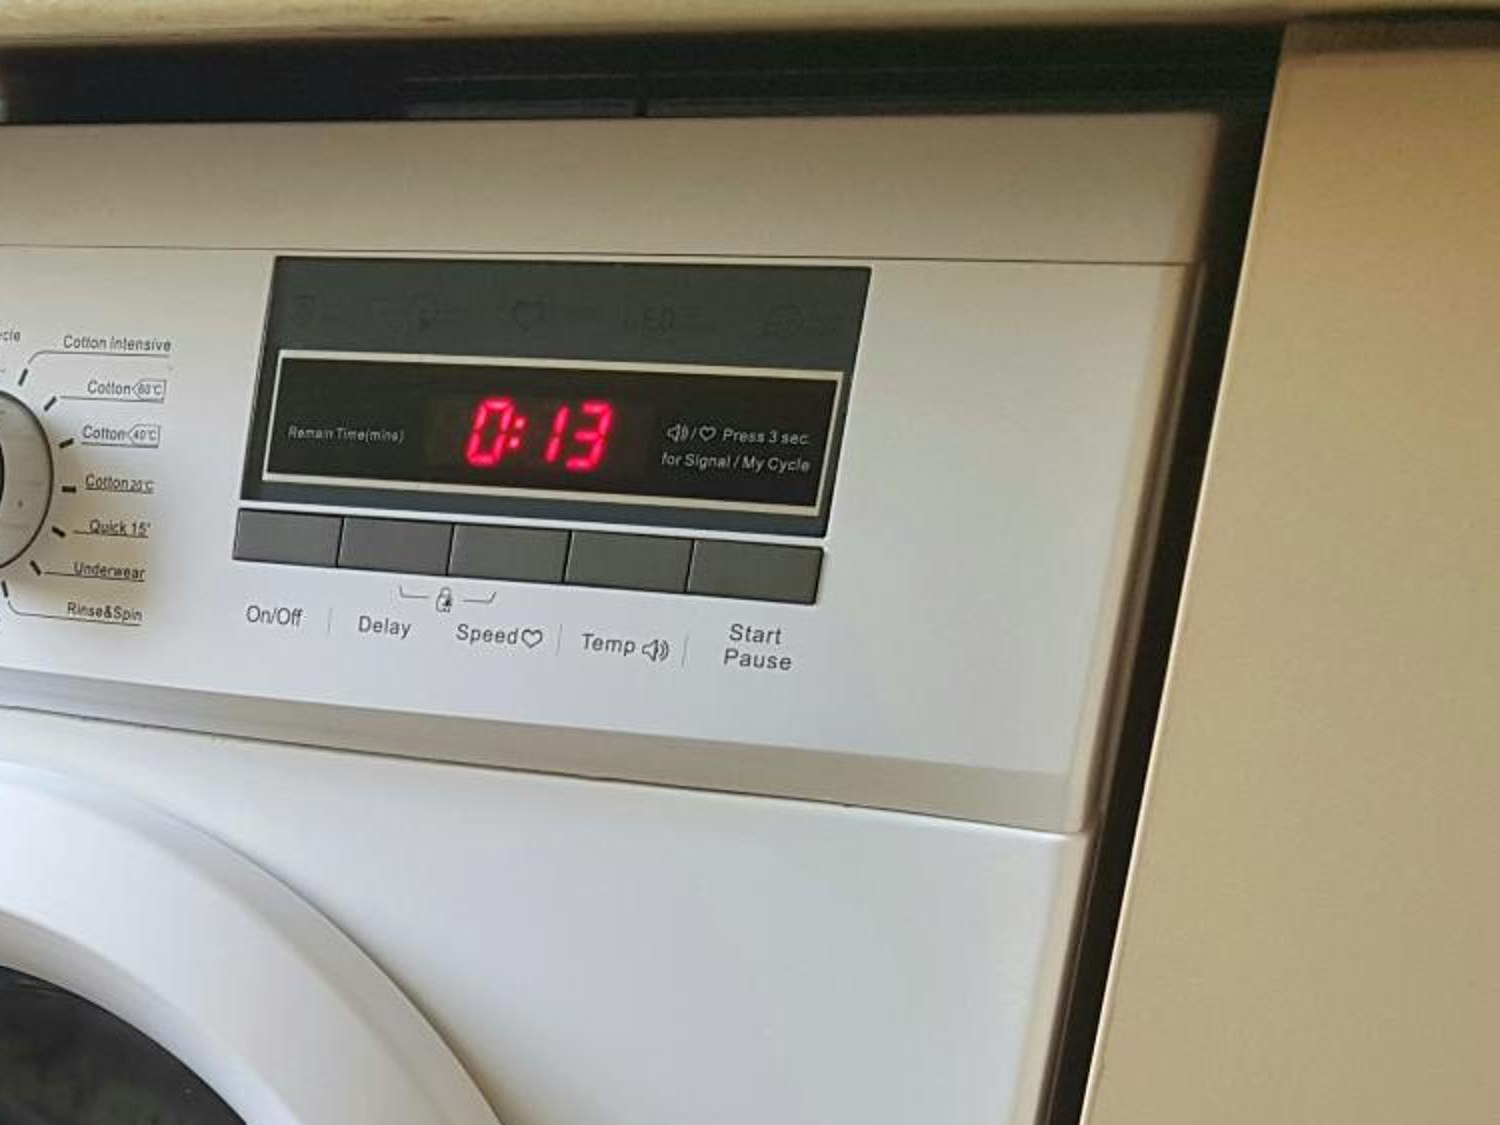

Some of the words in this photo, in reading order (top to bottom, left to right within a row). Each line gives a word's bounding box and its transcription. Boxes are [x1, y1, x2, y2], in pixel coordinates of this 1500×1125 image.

[63, 334, 107, 350] Cotton
[109, 337, 173, 352] Intensive
[87, 378, 132, 396] Cotton
[82, 424, 126, 441] Cotton
[464, 396, 613, 472] 0:13
[722, 427, 765, 444] Press
[769, 429, 778, 444] 3
[661, 452, 681, 466] for
[683, 453, 731, 470] Signal
[741, 455, 765, 473] My
[766, 457, 810, 474] Cycle
[85, 473, 129, 491] Cotton
[89, 519, 127, 536] Quick
[72, 560, 146, 581] Underwear
[67, 601, 143, 623] Rinse&Spin
[246, 605, 303, 627] On/Off
[357, 614, 412, 639] Delay
[455, 623, 518, 645] Speed
[729, 623, 782, 645] Start
[582, 633, 636, 656] Temp
[723, 648, 792, 671] Pause
